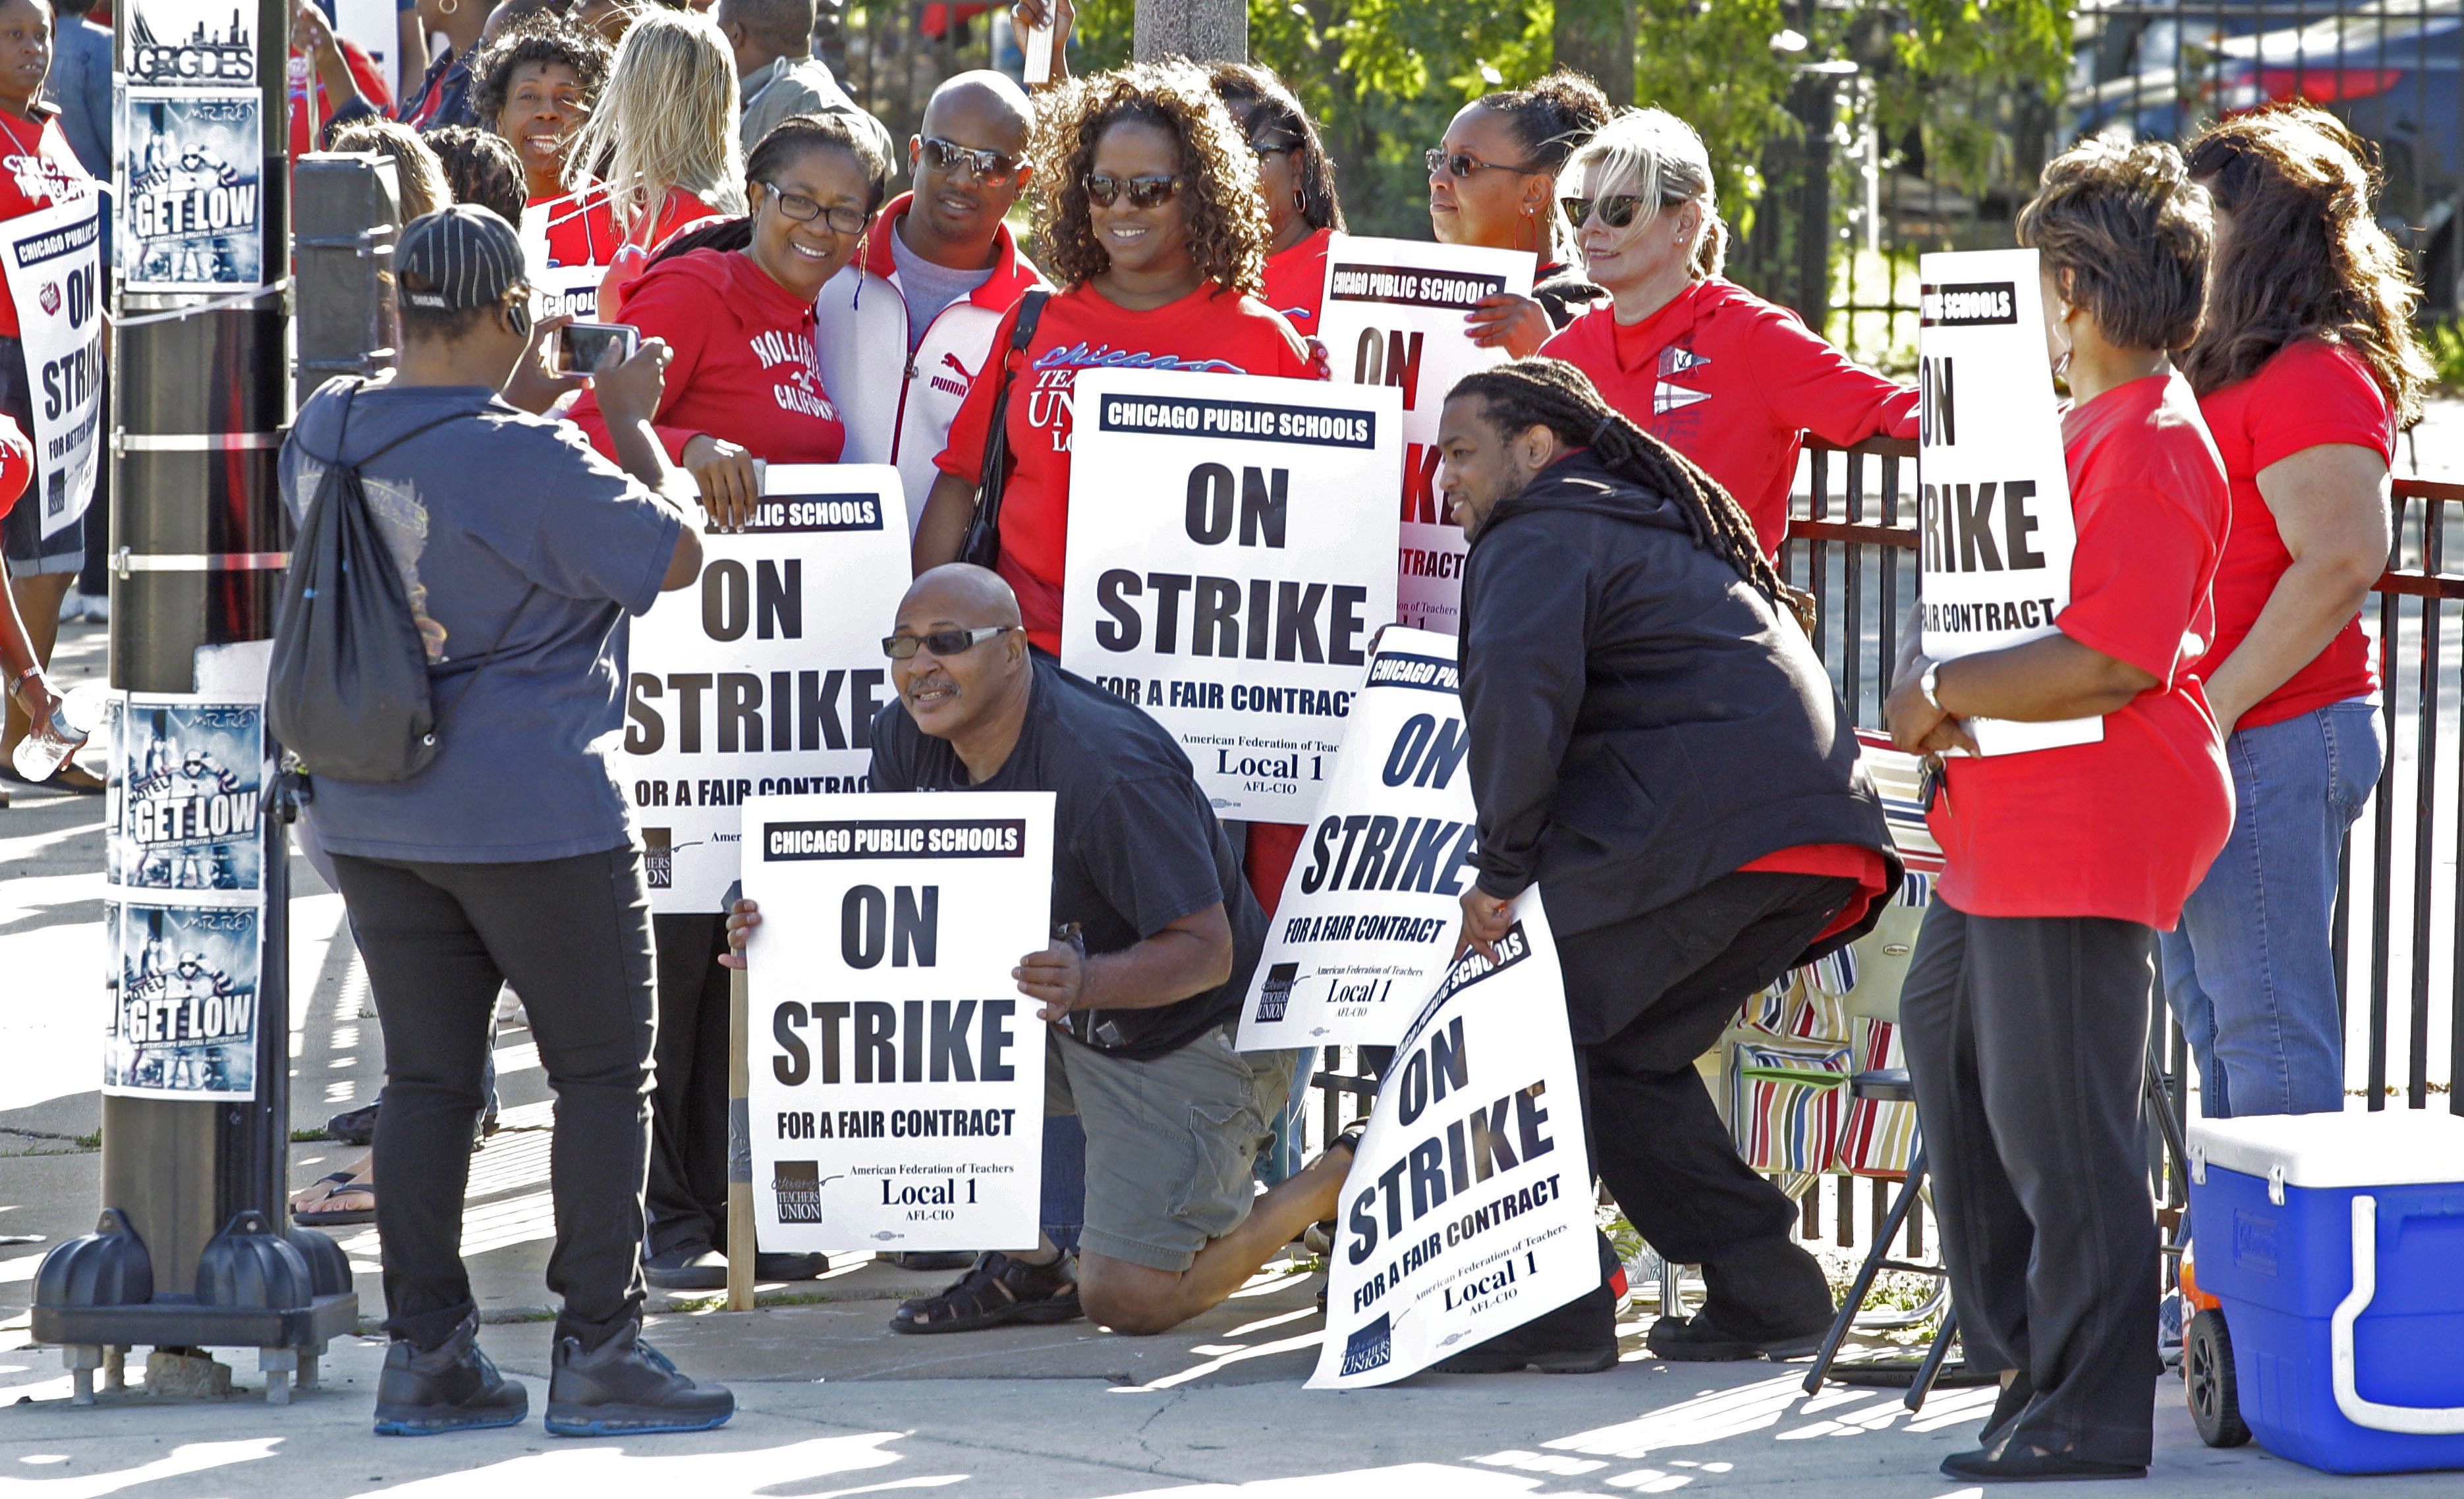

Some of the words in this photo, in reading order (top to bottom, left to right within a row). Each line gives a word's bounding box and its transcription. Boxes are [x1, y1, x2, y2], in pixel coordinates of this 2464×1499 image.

[135, 190, 188, 239] GET
[193, 184, 256, 231] LOW
[18, 234, 64, 263] CHICAGO
[65, 224, 92, 249] PUBLIC
[67, 259, 94, 330] ON
[1333, 270, 1368, 296] CHICAGO
[1369, 273, 1417, 298] PUBLIC
[543, 291, 598, 317] CHOOL
[1944, 290, 2011, 319] SCHOOLS
[42, 326, 100, 422] STRIK
[1354, 326, 1424, 411] ON
[930, 375, 968, 398] PUMA
[1922, 355, 1955, 449] ON
[1107, 402, 1199, 430] CHICAGO
[1203, 407, 1275, 435] PUBLIC
[1279, 412, 1368, 443] SCHOOLS
[48, 435, 65, 462] FOR
[789, 501, 875, 526] SCHOOLS
[1185, 462, 1289, 549] ON
[1924, 479, 2046, 573] RIKE
[1398, 548, 1465, 580] TRACT
[702, 559, 802, 643] ON
[1420, 602, 1458, 616] Teachers
[1922, 603, 1940, 633] AIR
[1944, 598, 2055, 634] CONTRACT
[1095, 568, 1368, 667] STRIKE
[1372, 659, 1434, 686] CHICAGO
[624, 668, 885, 755] STRIKE
[1146, 679, 1163, 707] A
[1170, 680, 1224, 710] FAIR
[1231, 684, 1357, 717] CONTRAC
[1181, 733, 1235, 746] American
[1239, 736, 1297, 750] Federation
[1301, 740, 1312, 751] of
[1314, 740, 1339, 753] Teac
[1382, 713, 1470, 790] ON
[1216, 748, 1299, 779] Local
[1310, 755, 1324, 781] 1
[634, 778, 669, 807] OR
[675, 778, 692, 806] A
[698, 777, 751, 807] FAIR
[758, 775, 869, 795] CONTRA
[1243, 780, 1297, 795] AFL-CIO
[134, 798, 188, 843] GET
[195, 790, 257, 838] LOW
[711, 831, 742, 842] Amer
[770, 829, 851, 855] CHICAGO
[855, 828, 924, 853] PUBLIC
[928, 827, 1018, 852] SCHOOLS
[1301, 814, 1478, 896] STRIKE
[841, 884, 939, 970] ON
[1282, 917, 1312, 944] FOR
[1308, 916, 1318, 942] A
[1320, 915, 1354, 942] FAIR
[1355, 914, 1447, 944] CONTRACT
[1316, 965, 1345, 975] American
[1346, 964, 1381, 975] Federation
[1383, 964, 1391, 975] of
[1392, 965, 1423, 977] Teachers
[1326, 978, 1378, 1003] Local
[1380, 979, 1393, 1003] 1
[128, 998, 183, 1044] GET
[188, 992, 252, 1040] LOW
[1258, 1002, 1286, 1020] UNION
[1335, 1006, 1367, 1018] AFL-CIO
[773, 999, 1016, 1087] STRIKE
[1399, 1014, 1469, 1127] ON
[777, 1111, 814, 1140] FOR
[820, 1111, 835, 1139] A
[839, 1110, 885, 1139] FAIR
[891, 1108, 1016, 1138] CONTRACT
[850, 1164, 897, 1176] American
[899, 1163, 954, 1175] Federation
[956, 1163, 967, 1174] of
[968, 1162, 1015, 1174] Teachers
[1348, 1079, 1555, 1266] STRIKE
[778, 1191, 819, 1203] TEACHERS
[881, 1178, 955, 1205] Local
[966, 1177, 978, 1205] 1
[779, 1203, 820, 1219] UNION
[905, 1209, 955, 1222] AFL-CIO
[1353, 1272, 1386, 1315] FOR
[1389, 1261, 1401, 1290] A
[1403, 1232, 1442, 1278] FAIR
[1446, 1173, 1561, 1248] CONTRACT
[1414, 1274, 1456, 1303] American
[1458, 1248, 1509, 1278] Federation
[1512, 1240, 1523, 1253] of
[1523, 1223, 1568, 1247] Teachers
[1443, 1259, 1517, 1313] Local
[1524, 1250, 1540, 1276] 1
[1469, 1288, 1518, 1317] AFL-CIO
[1343, 1348, 1389, 1375] UNION
